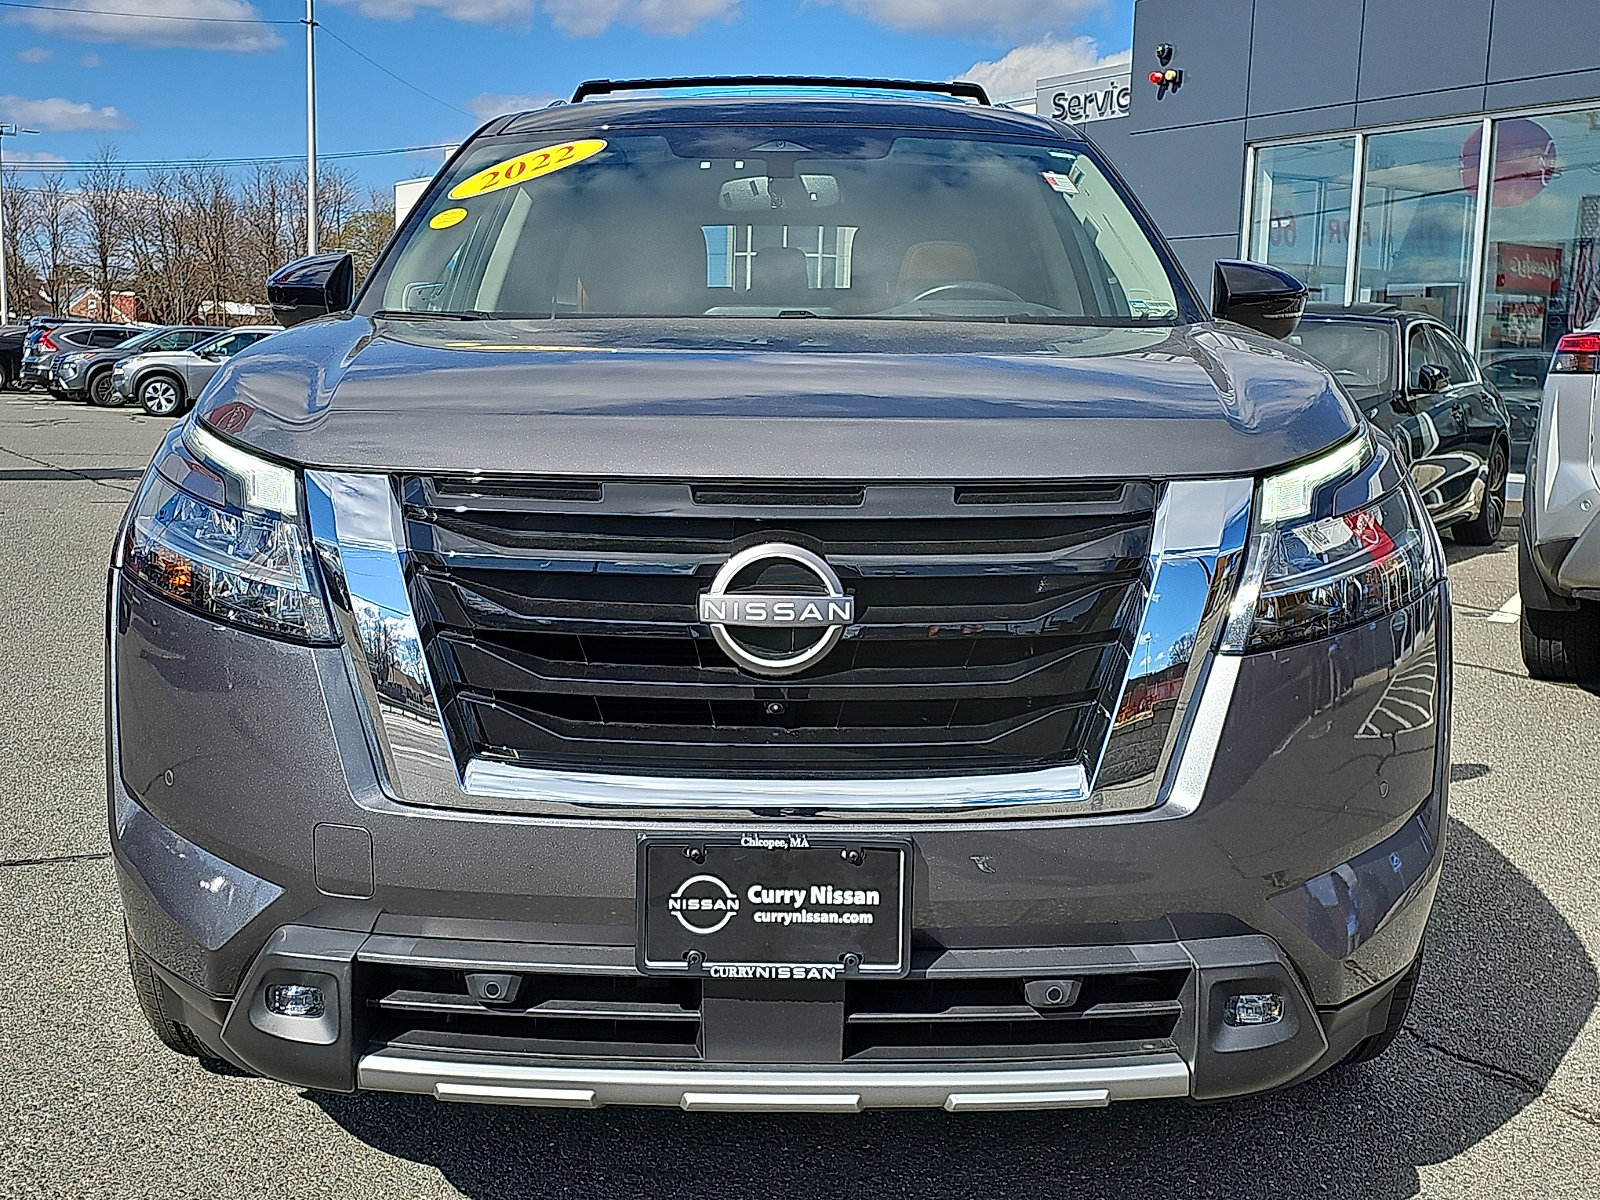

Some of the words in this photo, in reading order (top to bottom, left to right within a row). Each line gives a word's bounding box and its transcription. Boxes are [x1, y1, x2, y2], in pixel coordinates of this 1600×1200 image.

[480, 145, 574, 191] 2022
[704, 601, 851, 621] NISSAN
[789, 836, 810, 848] MA
[668, 899, 740, 910] NISSAN
[747, 885, 807, 908] Curry
[810, 885, 880, 905] Nissan
[753, 909, 874, 926] currynissan.com
